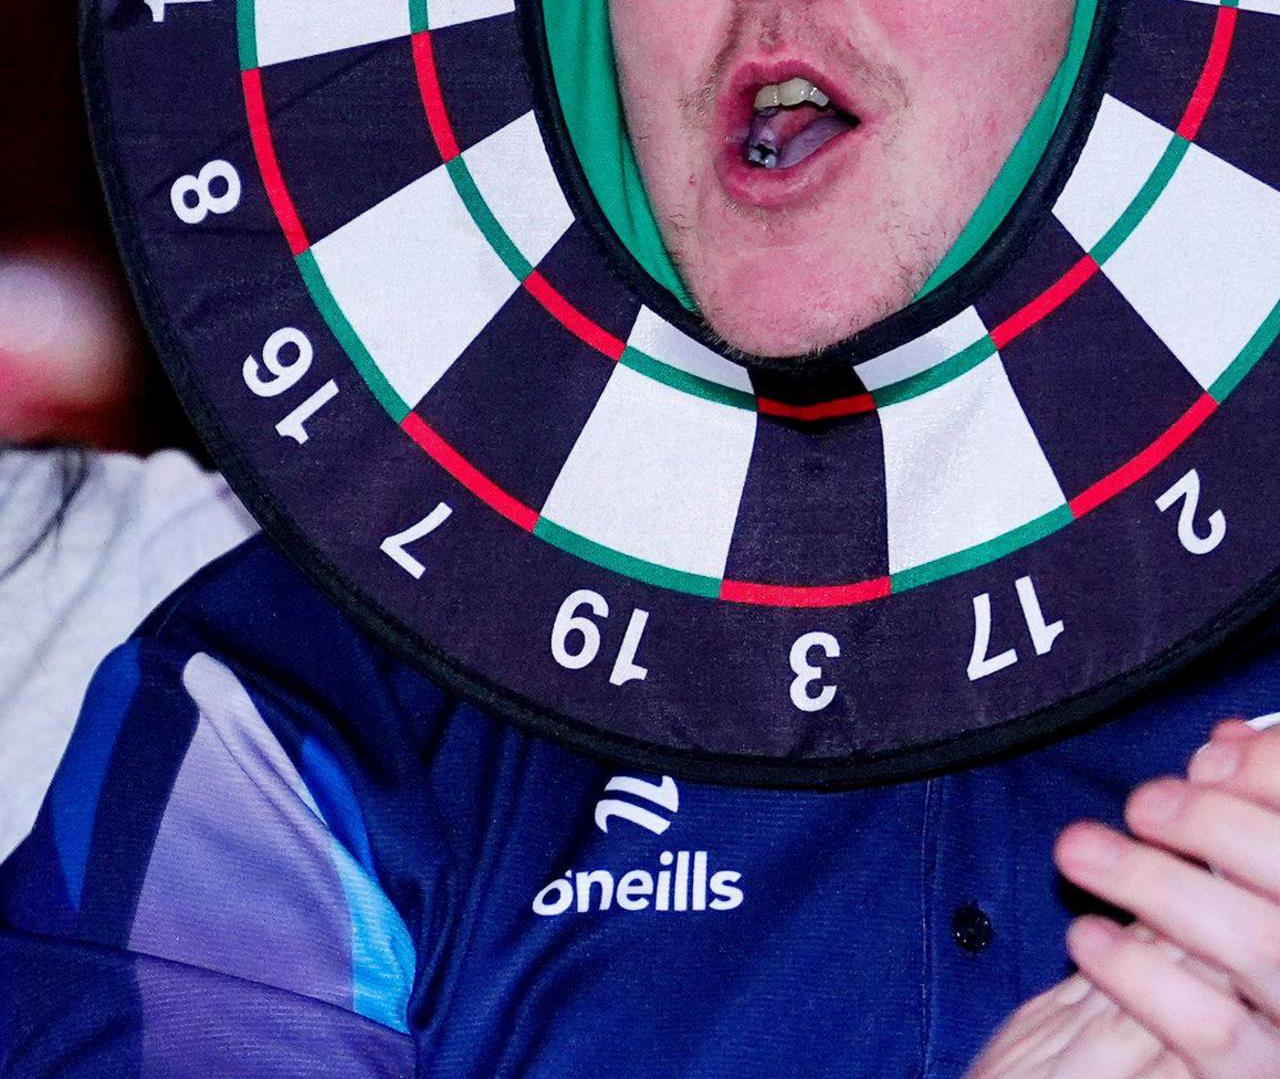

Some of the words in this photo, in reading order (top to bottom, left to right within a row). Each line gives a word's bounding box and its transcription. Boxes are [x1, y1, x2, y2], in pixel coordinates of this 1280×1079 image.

[170, 159, 242, 224] 8
[242, 326, 340, 445] 16
[379, 501, 453, 580] 7
[1154, 468, 1227, 555] 2
[550, 589, 650, 686] 19
[789, 631, 841, 712] 3
[966, 575, 1065, 681] 17
